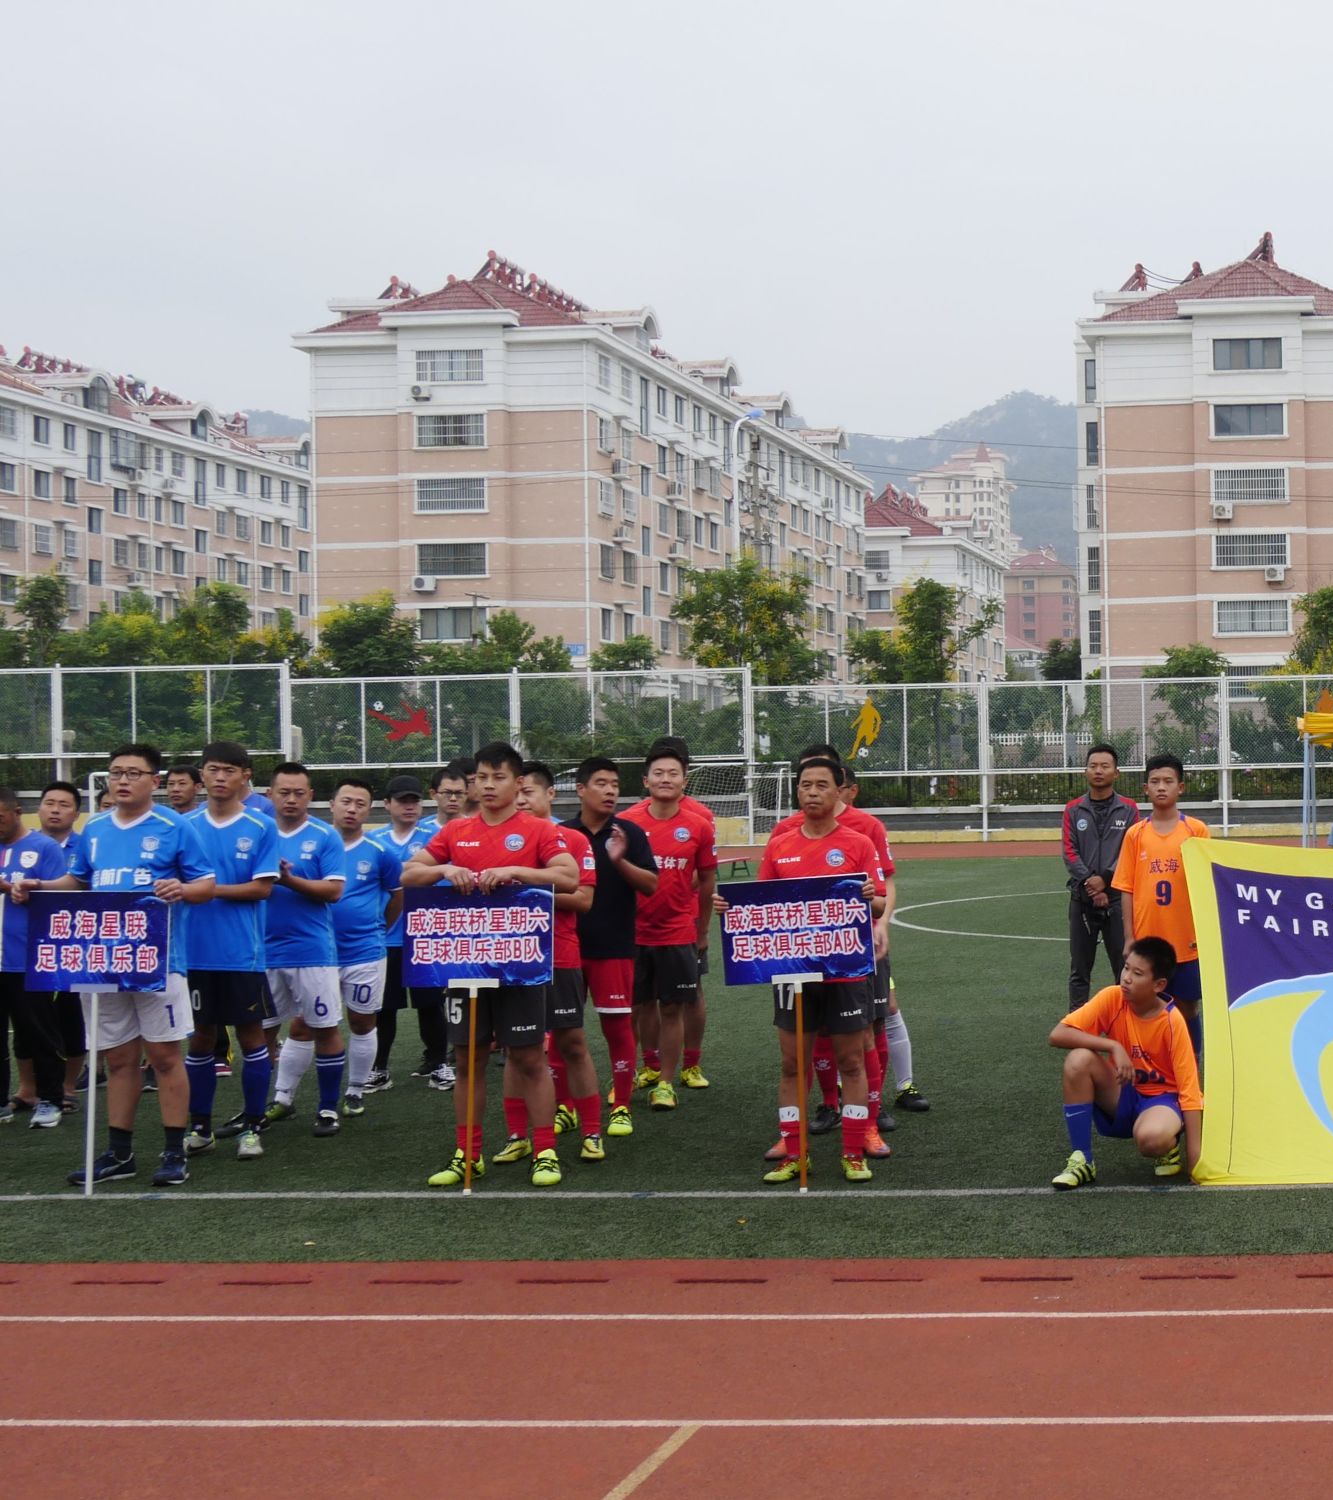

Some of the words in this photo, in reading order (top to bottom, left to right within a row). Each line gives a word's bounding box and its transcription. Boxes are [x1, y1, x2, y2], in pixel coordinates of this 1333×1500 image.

[1156, 880, 1172, 906] 9
[1236, 883, 1282, 906] MY
[49, 910, 148, 941] 威海星联
[407, 907, 550, 936] 威海联桥星期六
[724, 898, 868, 934] 威海联桥星期六
[1237, 909, 1329, 937] FAIR
[35, 944, 160, 973] 足球俱乐部
[411, 937, 544, 965] 足球俱乐部B队
[731, 927, 865, 963] 足球俱乐部A队
[314, 996, 328, 1017] 6
[352, 984, 371, 1004] 10
[165, 1004, 176, 1028] 1
[512, 1024, 537, 1032] KELME
